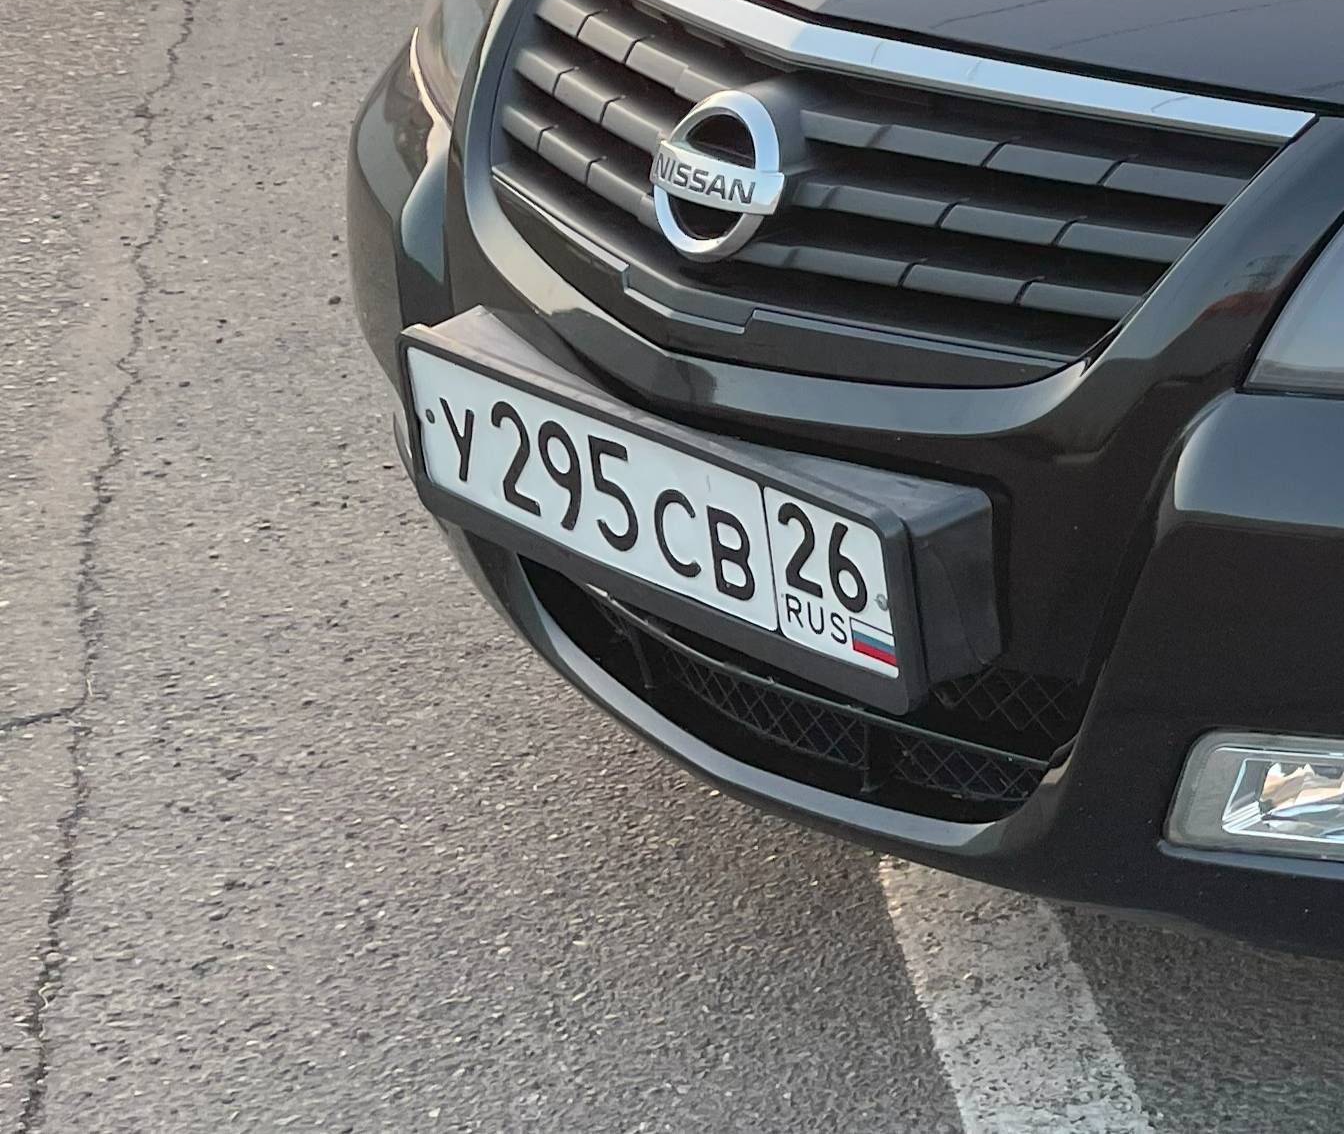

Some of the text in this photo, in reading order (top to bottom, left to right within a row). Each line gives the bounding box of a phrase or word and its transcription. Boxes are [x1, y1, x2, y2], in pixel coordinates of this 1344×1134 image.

[655, 152, 756, 204] NISSAN
[777, 501, 869, 614] 26
[783, 593, 848, 645] RUS
